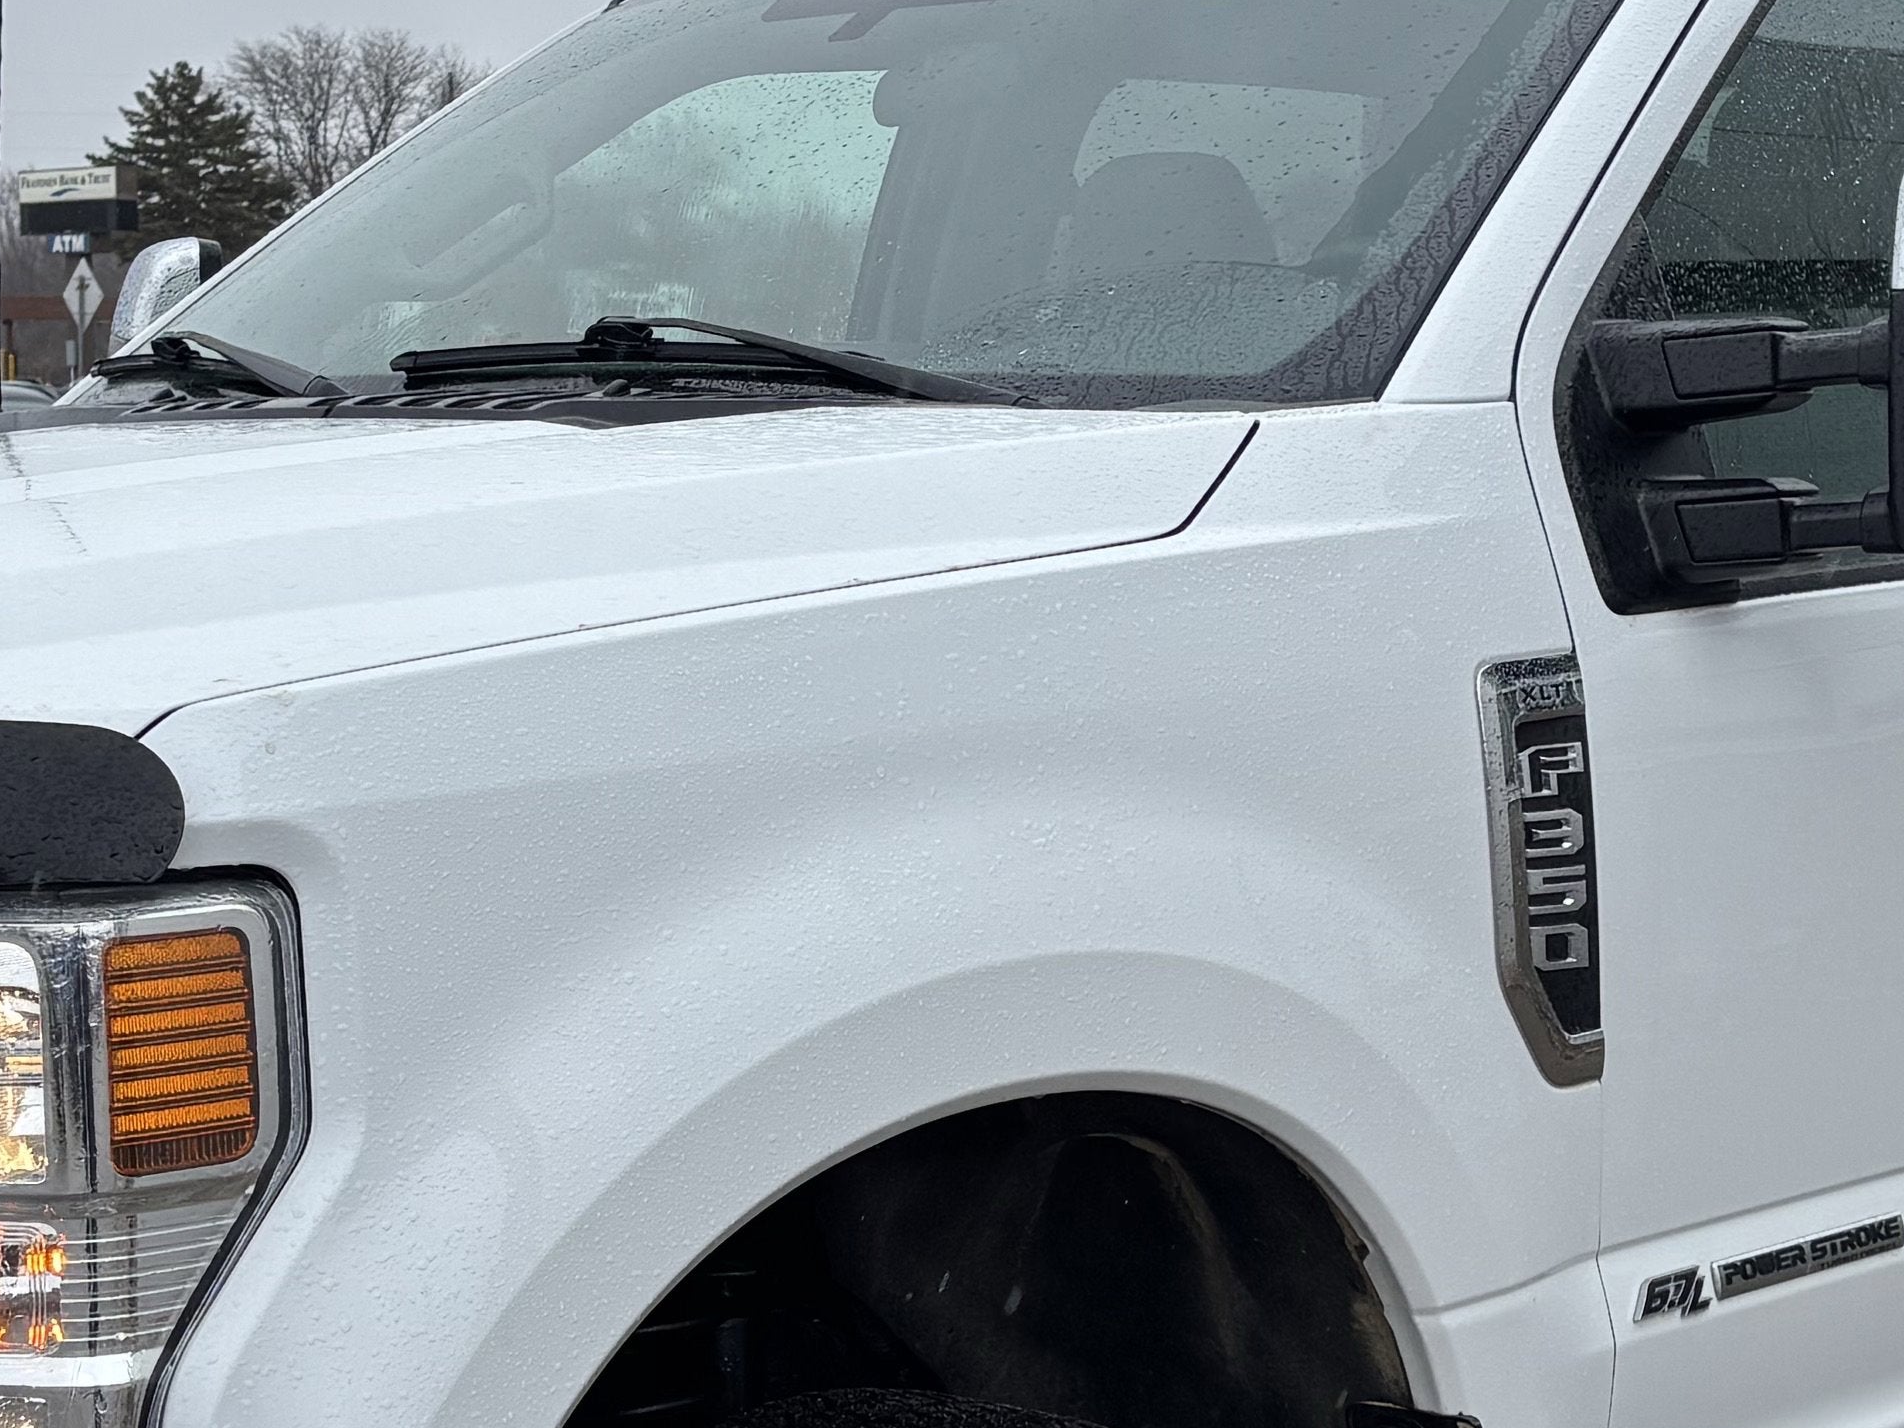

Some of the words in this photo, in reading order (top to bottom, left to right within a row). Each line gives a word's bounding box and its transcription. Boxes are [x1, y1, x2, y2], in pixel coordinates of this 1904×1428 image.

[52, 234, 85, 253] ATM
[1520, 682, 1564, 703] XLT
[1721, 1242, 1808, 1287] POWER
[1810, 1214, 1902, 1262] STROKE
